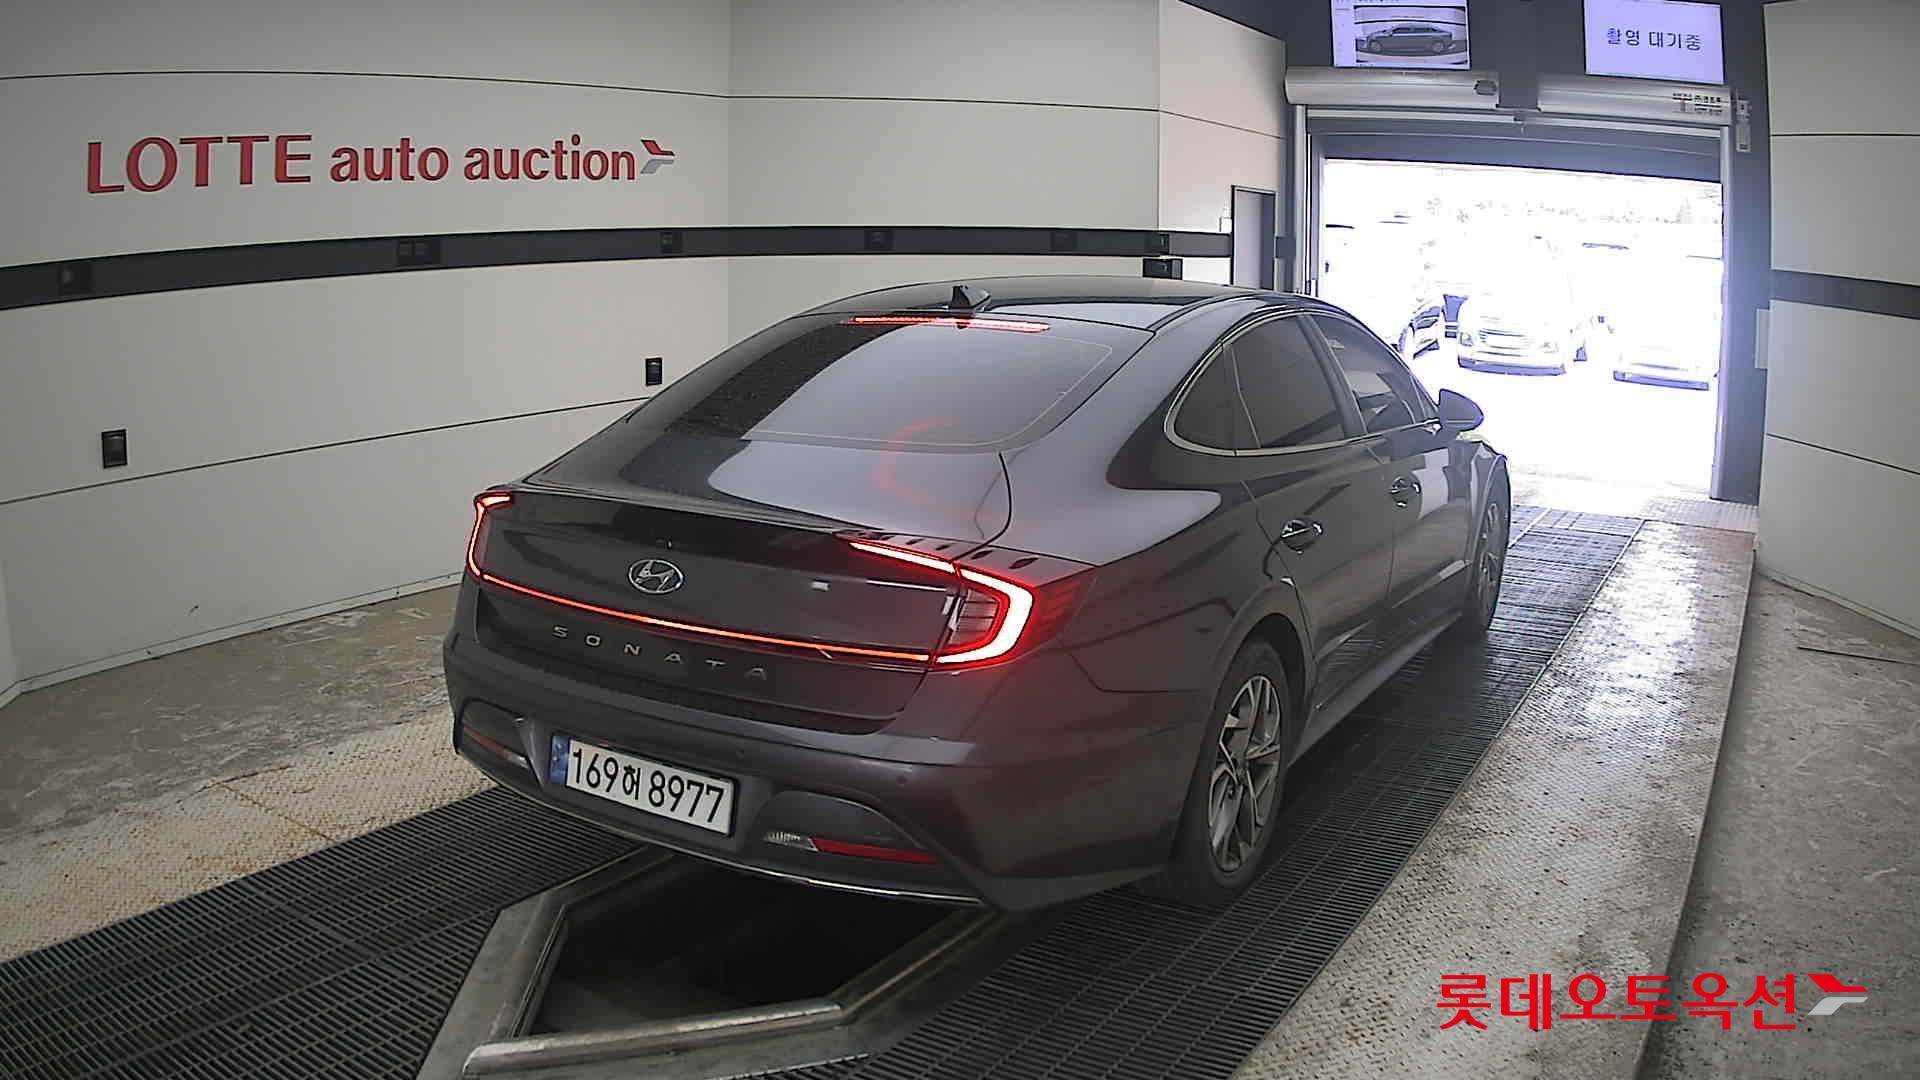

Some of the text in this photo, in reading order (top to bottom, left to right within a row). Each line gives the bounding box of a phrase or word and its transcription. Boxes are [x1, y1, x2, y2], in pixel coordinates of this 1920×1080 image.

[1648, 31, 1702, 52] 대기중
[87, 133, 636, 194] LOTTE auto auction
[552, 625, 768, 681] SONATA
[573, 748, 725, 824] 169허 8977
